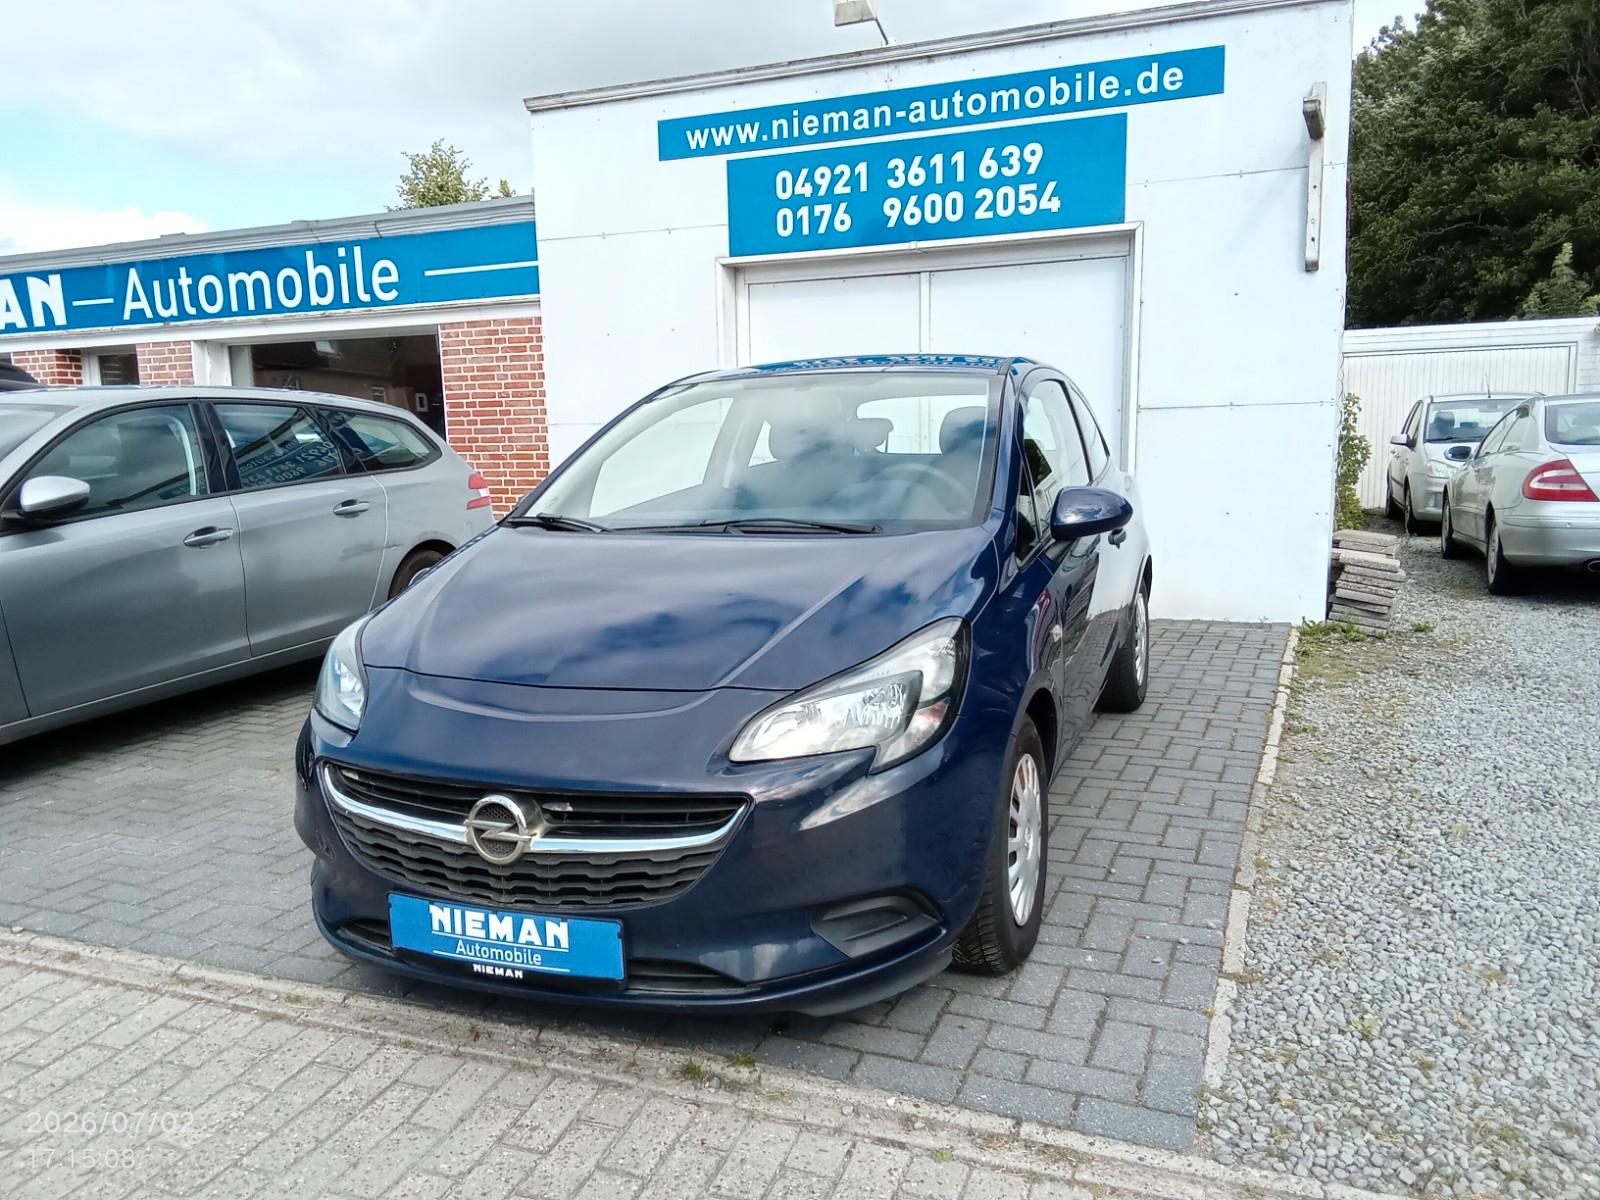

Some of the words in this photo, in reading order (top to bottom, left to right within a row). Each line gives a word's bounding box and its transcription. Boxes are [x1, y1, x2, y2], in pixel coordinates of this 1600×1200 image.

[686, 63, 1184, 150] www.nieman-automobile.de
[776, 161, 867, 200] 04921
[886, 151, 965, 189] 3611
[979, 142, 1044, 179] 639
[776, 202, 852, 237] 0176
[883, 191, 964, 228] 9600
[974, 181, 1060, 220] 2054
[123, 246, 399, 320] Automobile
[429, 904, 569, 949] NIEMAN
[455, 939, 542, 966] Automobile
[472, 963, 523, 979] NIEMAN
